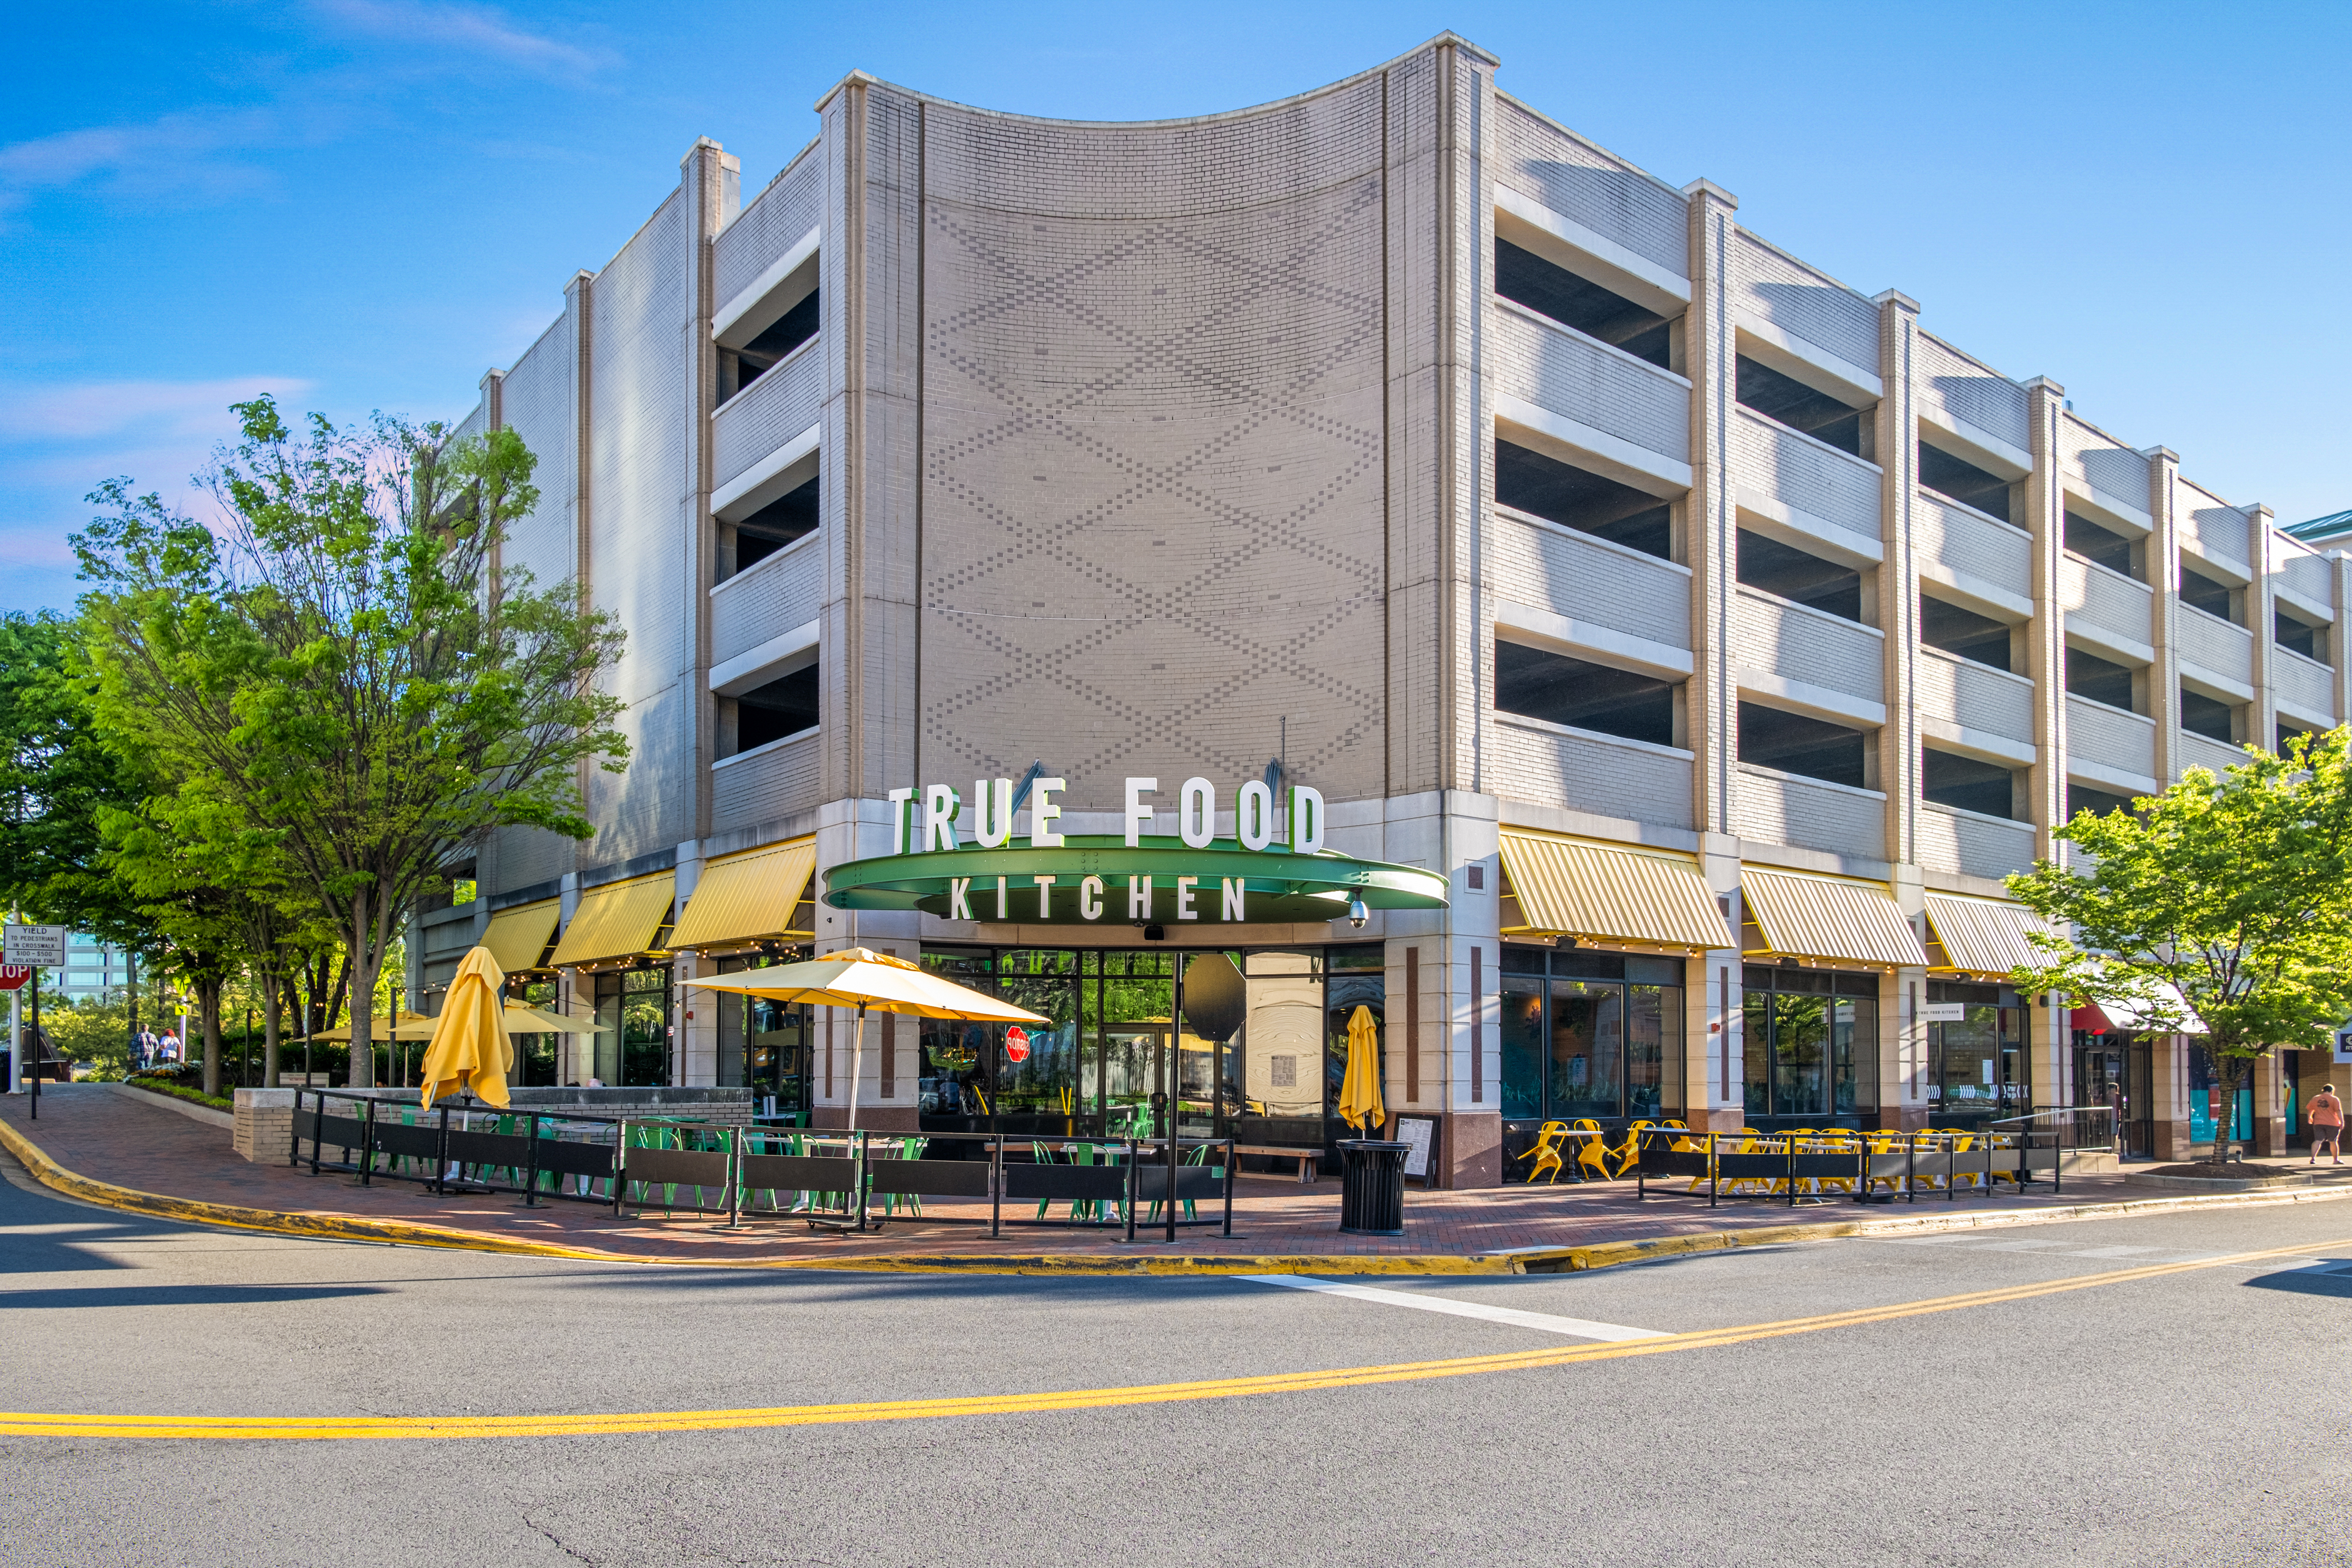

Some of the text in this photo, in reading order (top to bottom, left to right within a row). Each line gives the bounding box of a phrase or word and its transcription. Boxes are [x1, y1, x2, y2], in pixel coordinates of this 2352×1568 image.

[888, 777, 1324, 854] TRUE FOOD
[951, 875, 1245, 921] KITCHEN
